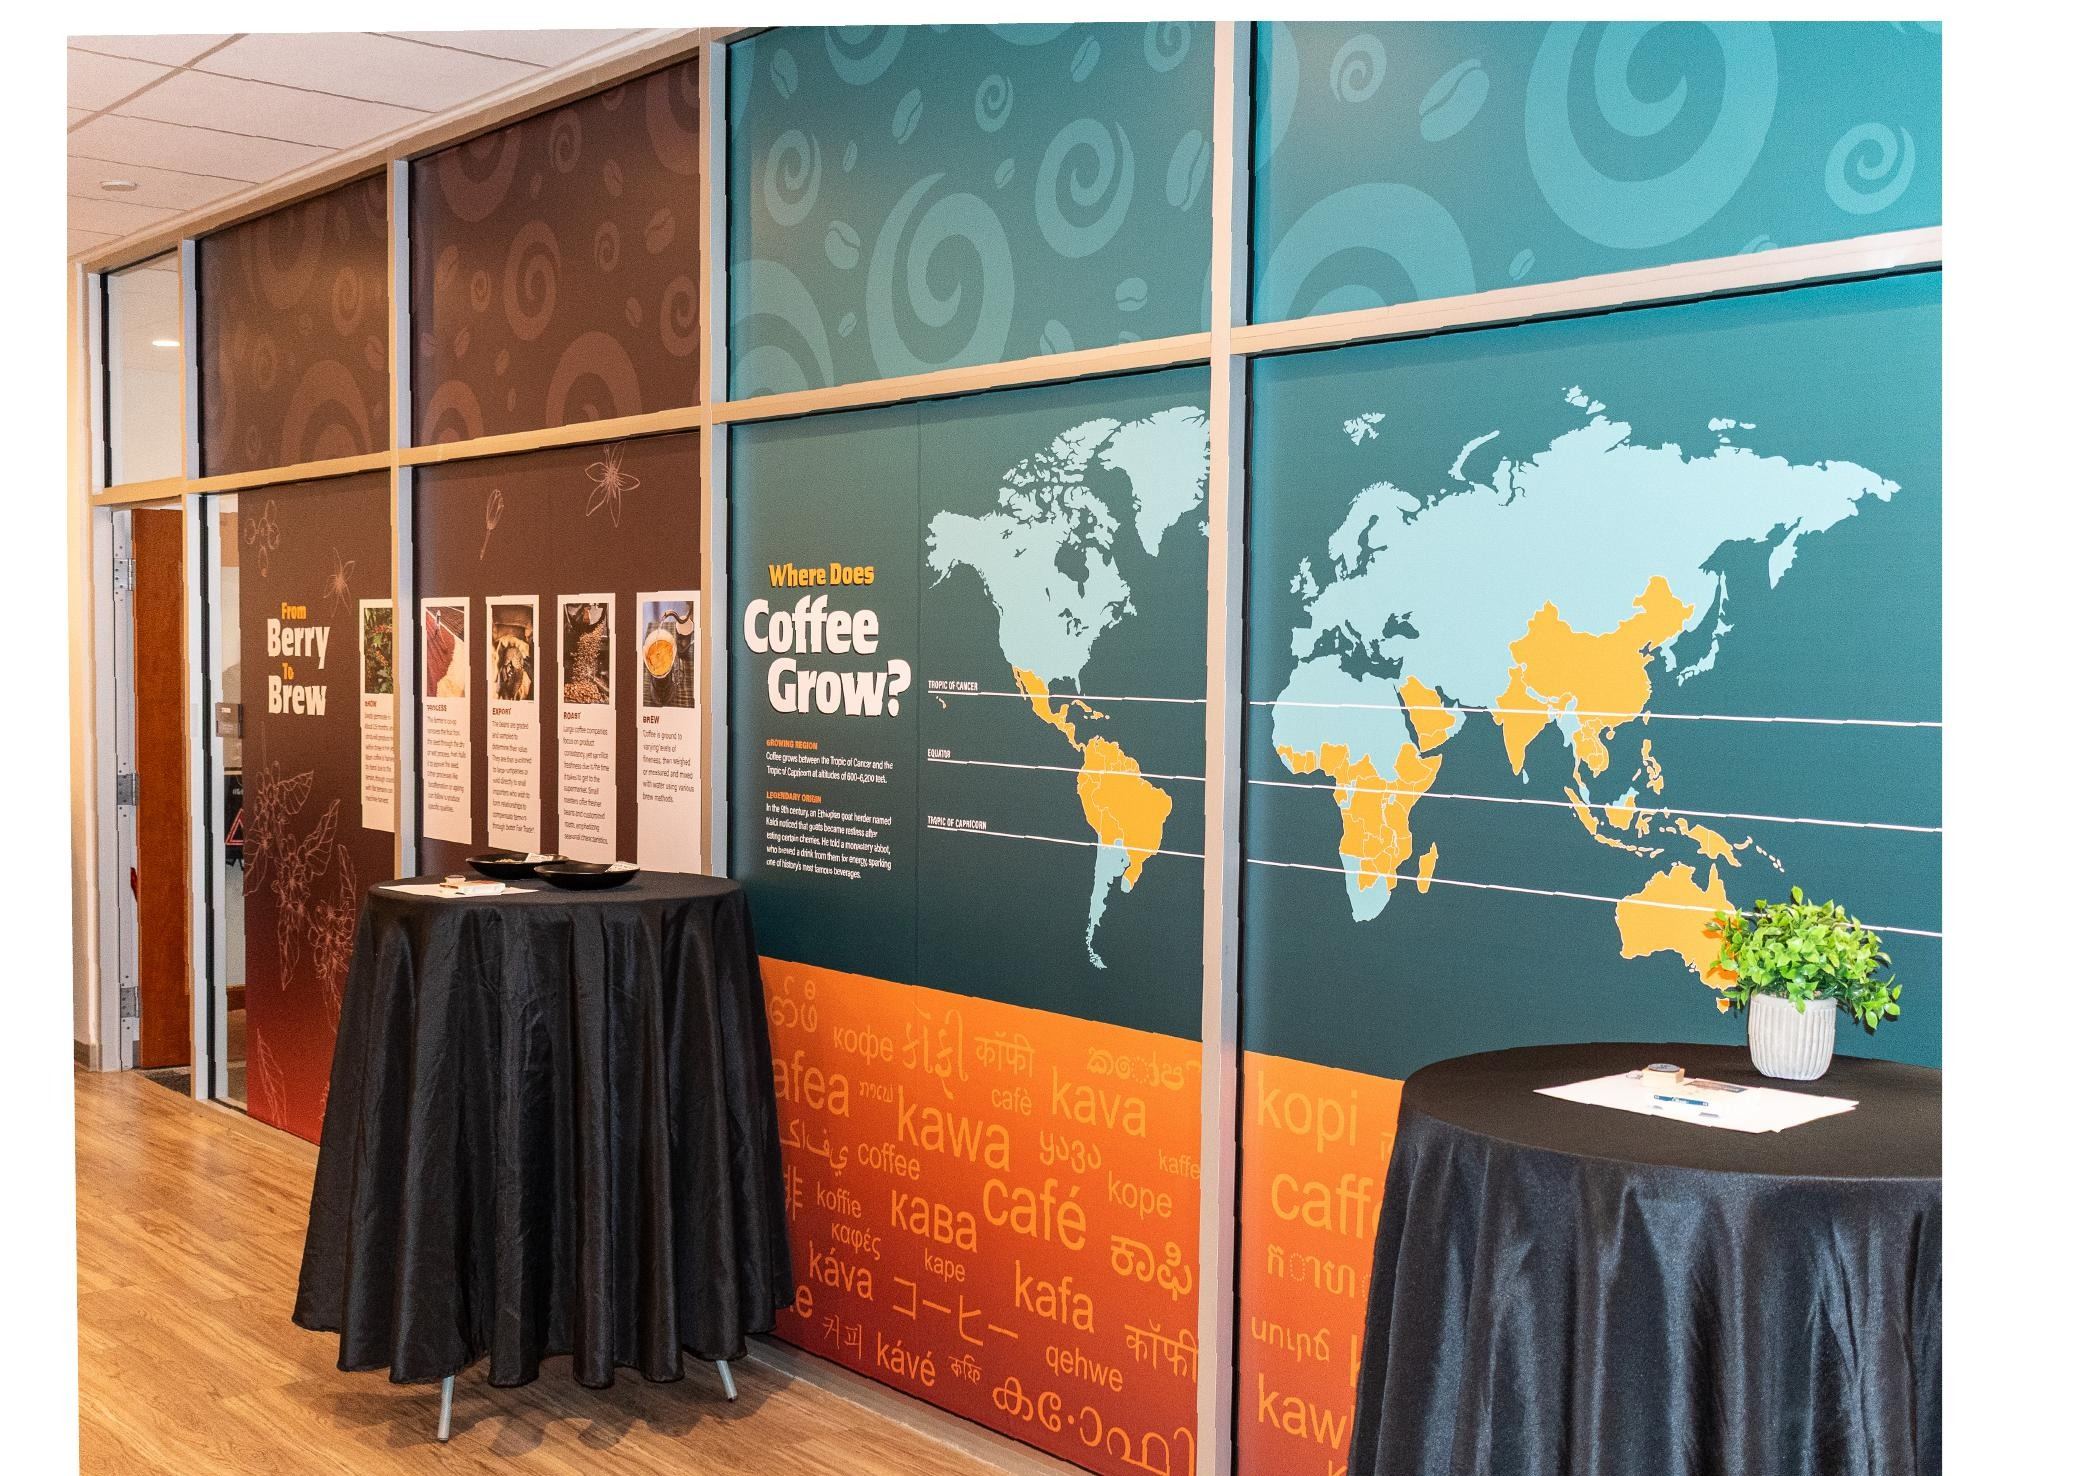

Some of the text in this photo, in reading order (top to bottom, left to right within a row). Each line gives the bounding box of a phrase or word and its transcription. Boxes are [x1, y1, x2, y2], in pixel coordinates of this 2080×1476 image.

[768, 562, 875, 588] Where Does
[281, 602, 307, 620] From
[743, 594, 879, 655] Coffee
[267, 618, 331, 670] Berry
[282, 662, 294, 680] To
[268, 674, 328, 716] Brew
[767, 657, 912, 718] Grow?
[928, 680, 978, 691] TROPIC OF CANCER
[492, 707, 512, 716] EXPORT
[563, 711, 581, 720] ROAST
[643, 715, 660, 724] BREW
[642, 729, 656, 738] Coffee
[662, 733, 677, 741] ground
[766, 739, 818, 750] GROWING REGION
[766, 751, 893, 769] Coffee grows between the Tropic of Cancer and the
[927, 748, 951, 759] EQUATOR
[767, 765, 781, 777] Tropic
[782, 766, 787, 775] of
[788, 767, 811, 778] Capricorn
[812, 770, 817, 778] at
[818, 769, 840, 780] altitudes
[841, 771, 846, 780] of
[766, 791, 821, 804] LEGENDARY ORIGIN
[766, 803, 771, 811] In
[772, 804, 780, 813] the
[781, 804, 789, 813] 9th
[790, 807, 809, 818] century,
[818, 809, 840, 821] Ethiopian
[841, 812, 853, 822] goat
[854, 811, 872, 823] herder
[873, 816, 892, 825] named
[927, 815, 987, 830] TROPIC OF CAPRICORN
[779, 818, 797, 829] noticed
[799, 820, 808, 830] that
[809, 822, 823, 831] goats
[824, 823, 844, 834] became
[846, 827, 864, 837] restless
[865, 828, 878, 838] after
[767, 832, 891, 855] eating certain cherries. He told a monastery abbot,
[767, 845, 777, 853] who
[778, 846, 796, 856] brewed
[801, 848, 814, 858] drink
[815, 850, 826, 860] from
[827, 852, 840, 862] them
[869, 858, 892, 871] sparking
[777, 859, 782, 867] of
[803, 864, 814, 872] most
[815, 864, 833, 874] famous
[834, 867, 861, 880] beverages.
[834, 1024, 893, 1066] кофе
[1052, 1065, 1146, 1138] kava
[1257, 1070, 1358, 1153] kopi
[898, 1084, 1010, 1173] kawa
[858, 1142, 920, 1180] coffee
[817, 1181, 862, 1218] koffie
[1107, 1170, 1173, 1220] kope
[809, 1239, 874, 1301] káva
[924, 1247, 966, 1283] kape
[1015, 1259, 1095, 1334] kafa
[892, 1276, 1019, 1347] コーヒー
[822, 1314, 862, 1361] 커피
[877, 1331, 936, 1387] kávé
[1045, 1345, 1123, 1392] qehwe
